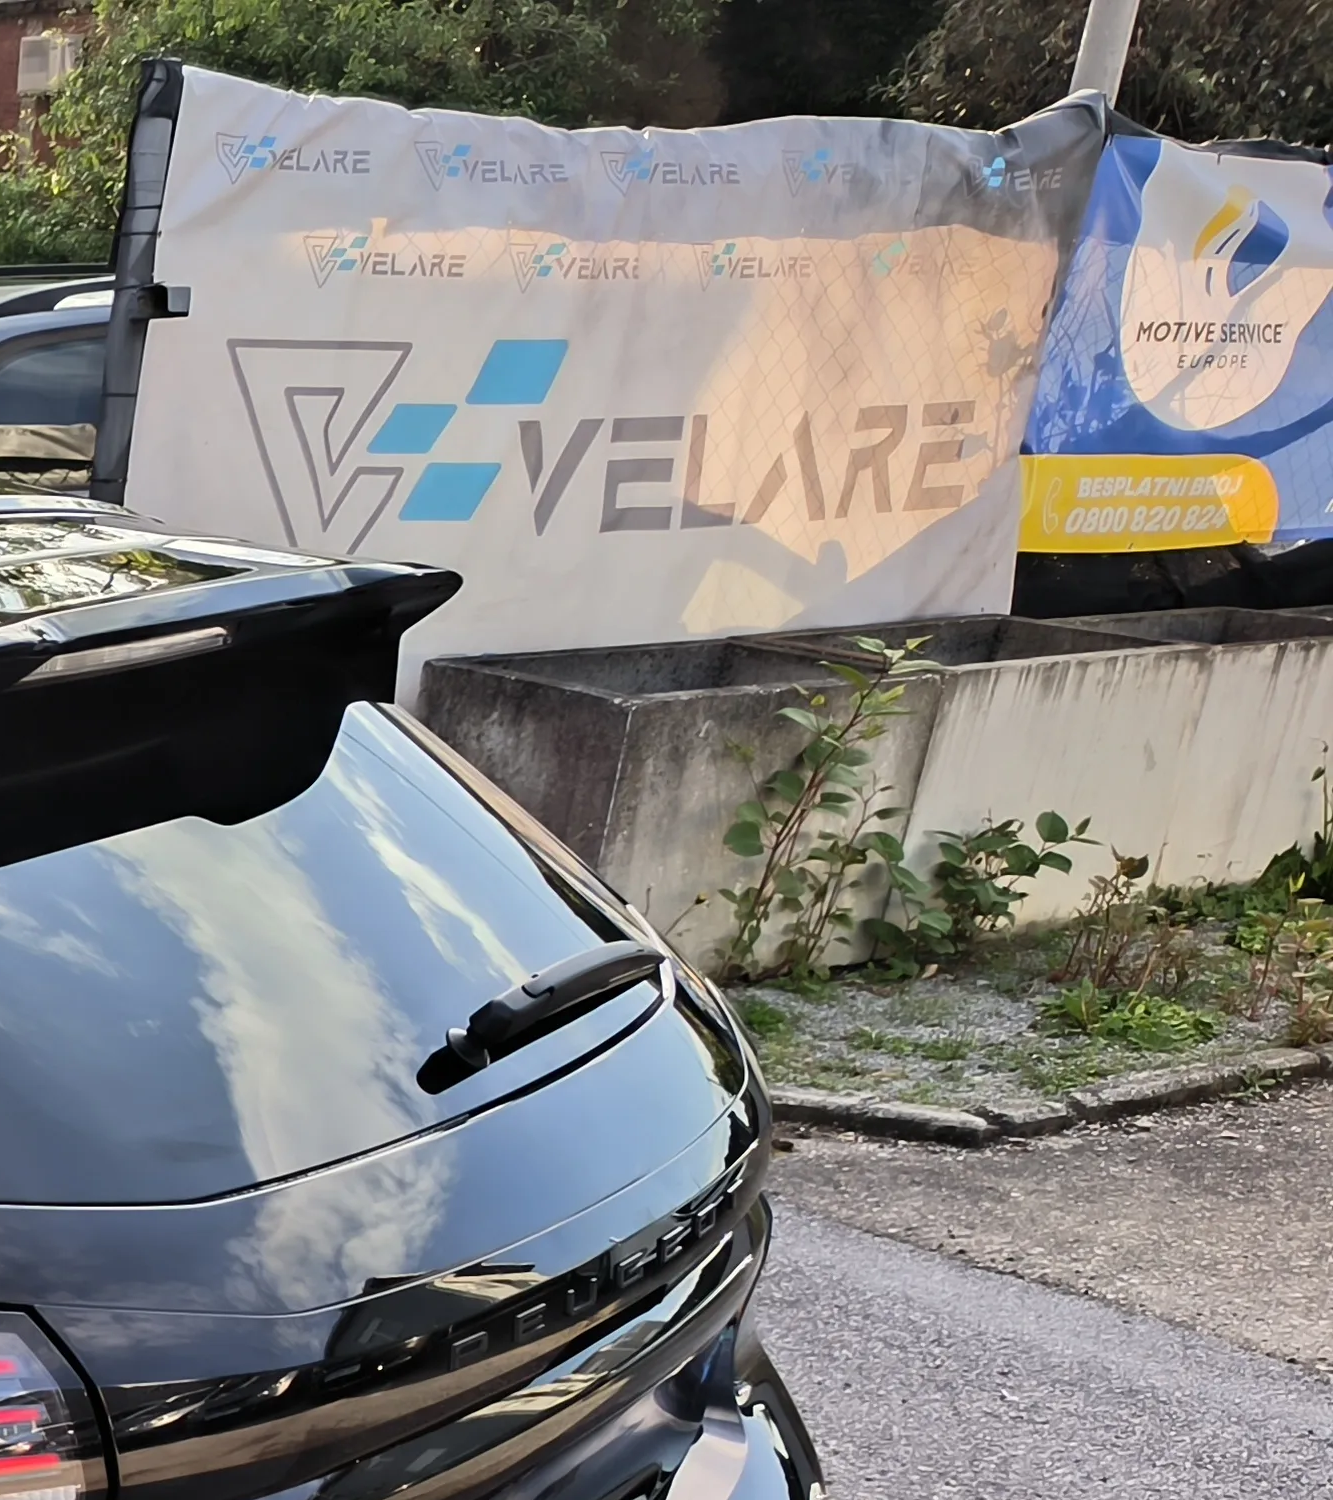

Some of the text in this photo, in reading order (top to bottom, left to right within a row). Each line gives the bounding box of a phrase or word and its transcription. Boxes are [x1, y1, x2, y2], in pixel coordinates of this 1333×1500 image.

[267, 147, 371, 174] VELARE
[462, 159, 569, 185] VELARE
[358, 252, 467, 278] VELARE
[727, 255, 813, 279] VELARE
[1136, 320, 1284, 344] MOTIVE SERVICE
[1176, 354, 1249, 370] EUROPE
[517, 399, 976, 536] VELARE
[1077, 474, 1245, 499] BESPLATNI BROJ
[1065, 505, 1230, 534] 0800 820 824
